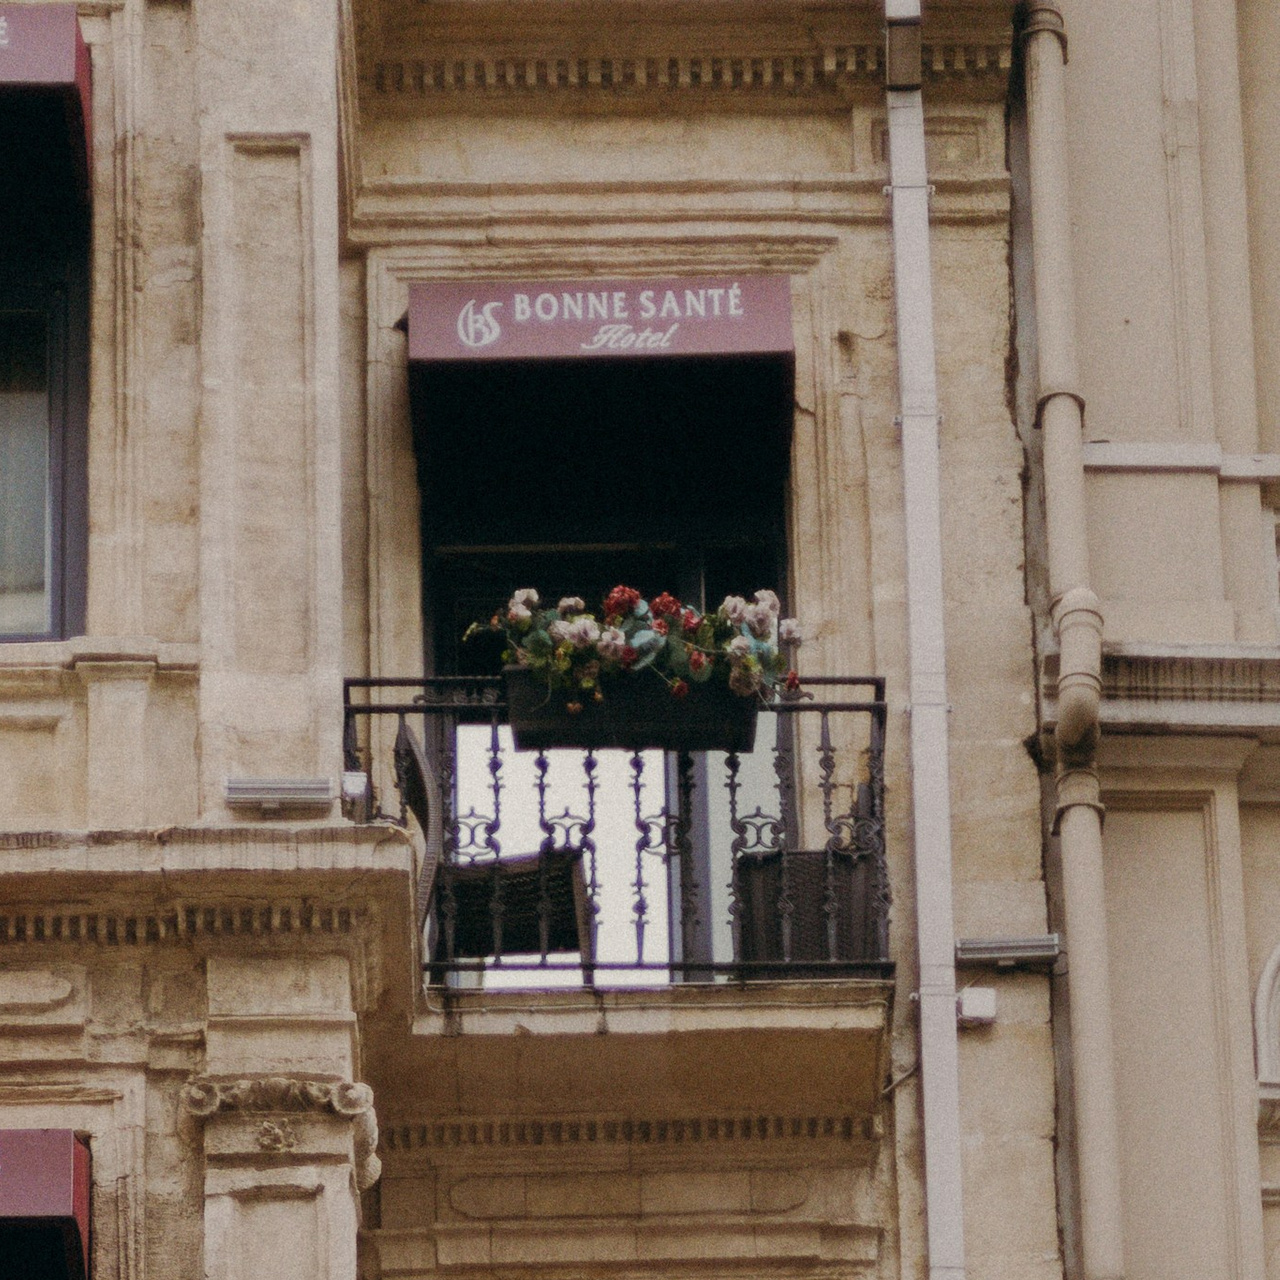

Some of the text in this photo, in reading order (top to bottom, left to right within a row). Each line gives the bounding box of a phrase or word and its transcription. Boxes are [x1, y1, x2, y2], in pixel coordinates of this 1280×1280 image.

[515, 282, 743, 321] BONNE SANTÉ
[581, 323, 678, 349] Hotel
